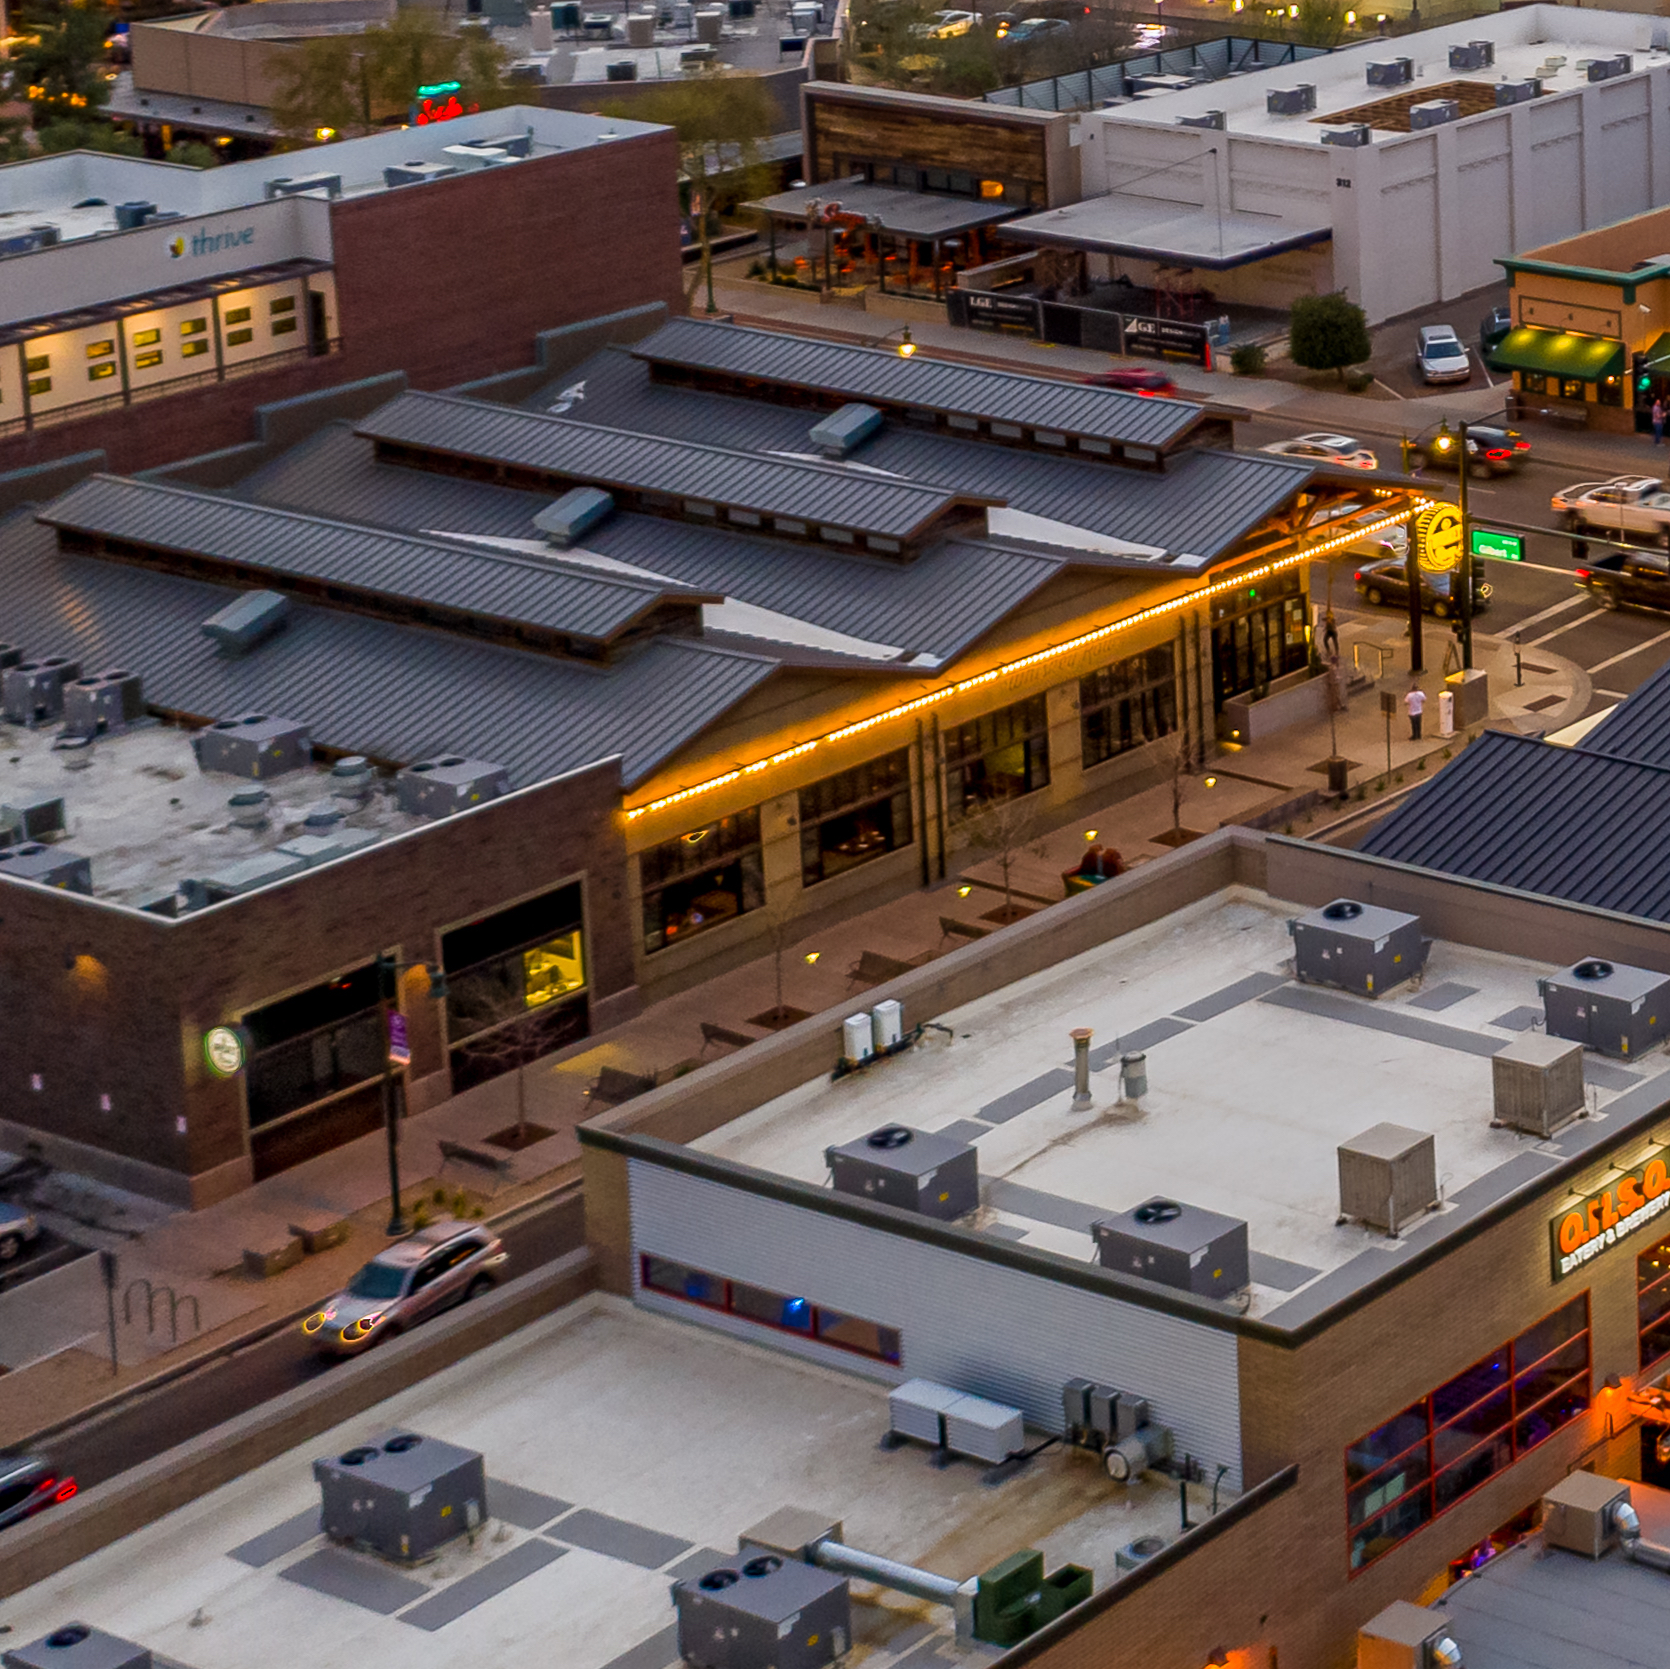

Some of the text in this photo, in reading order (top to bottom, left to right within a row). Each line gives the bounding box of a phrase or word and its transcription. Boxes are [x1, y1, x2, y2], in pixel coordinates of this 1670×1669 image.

[192, 225, 255, 257] thrive
[1560, 1232, 1606, 1274] EATERY
[1605, 1228, 1616, 1244] &
